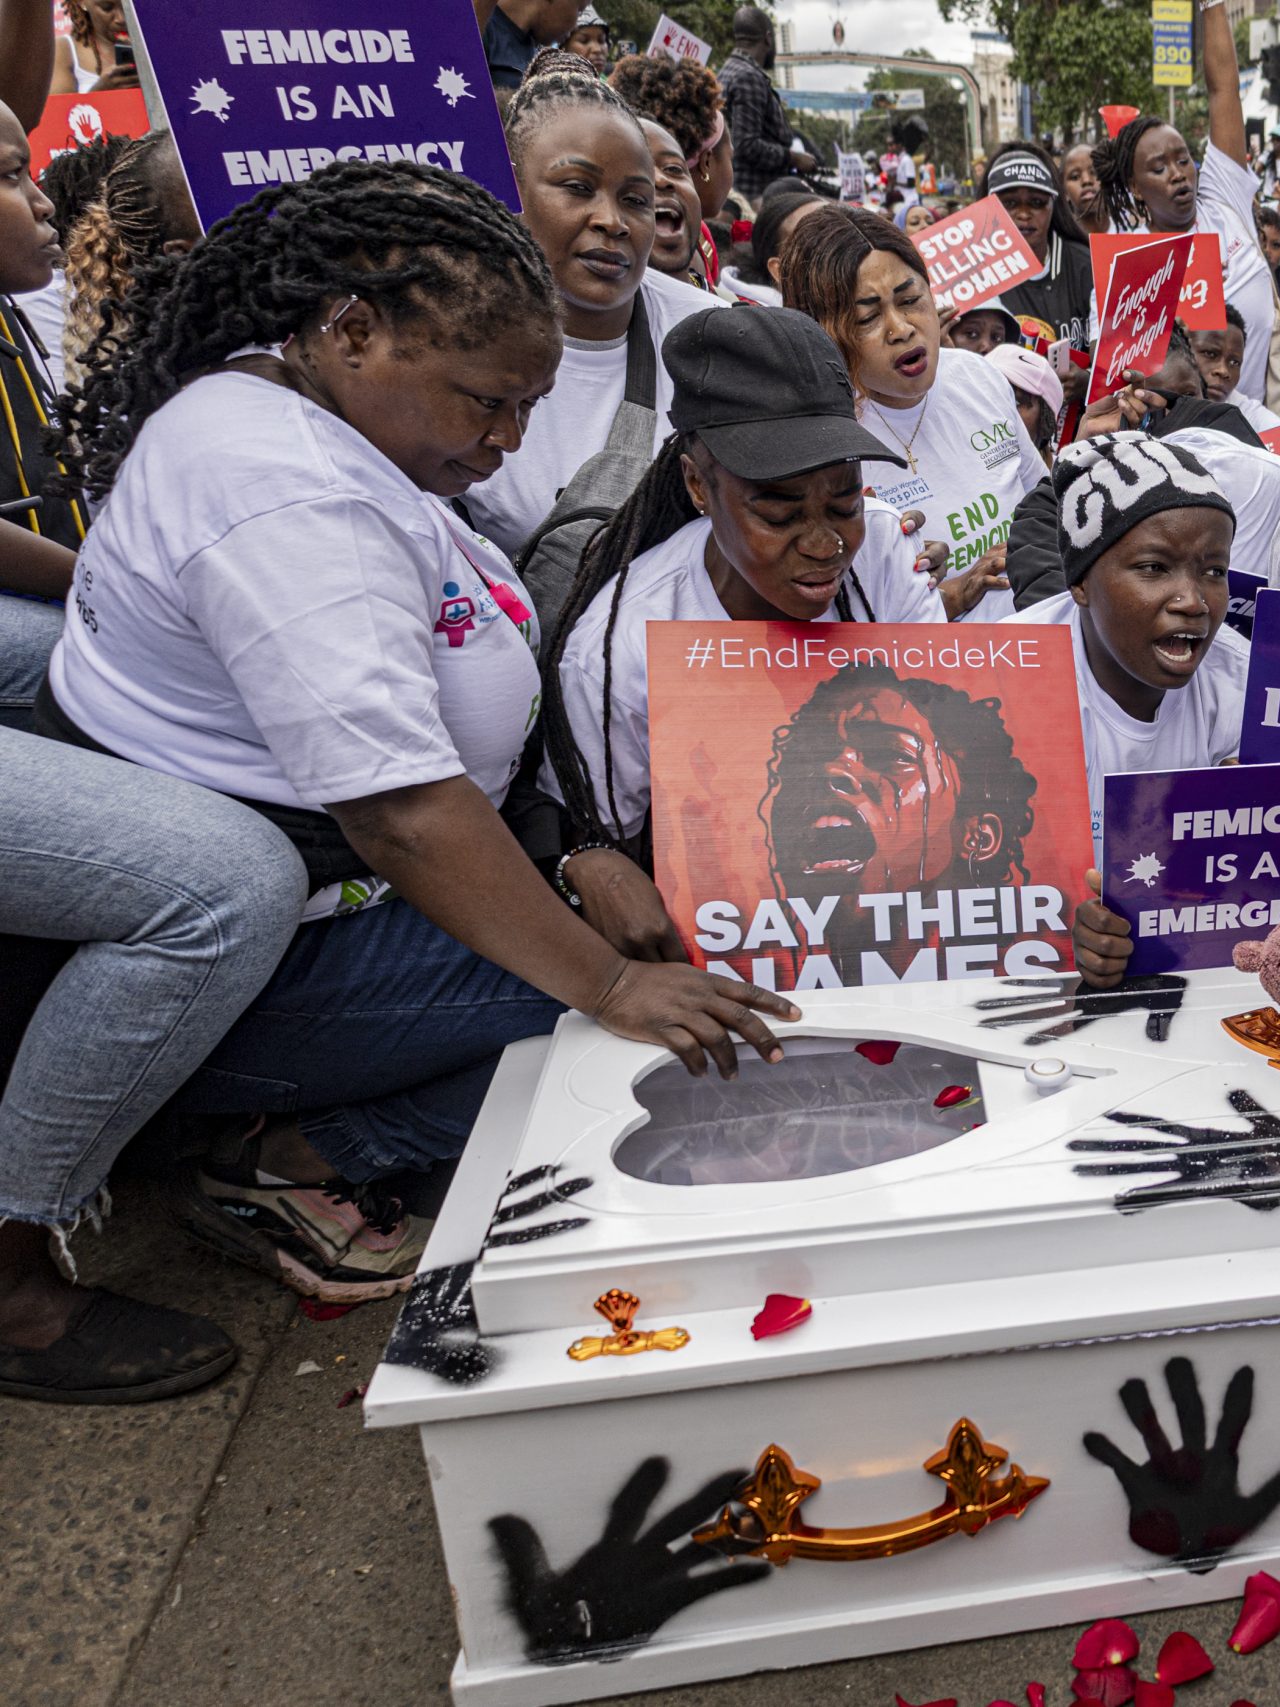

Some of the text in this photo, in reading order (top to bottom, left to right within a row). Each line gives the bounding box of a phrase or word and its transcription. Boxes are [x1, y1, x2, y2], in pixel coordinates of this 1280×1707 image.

[220, 29, 415, 64] FEMICIDE
[1154, 45, 1192, 63] 890
[276, 84, 396, 121] IS AN
[1004, 165, 1046, 180] CHANEL
[918, 219, 975, 260] STOP
[927, 229, 1013, 288] ILLING
[1112, 249, 1175, 330] Enough
[1132, 304, 1148, 336] is
[1105, 305, 1168, 387] Enough
[946, 492, 999, 541] END
[945, 512, 1016, 571] FEMICID
[684, 638, 1042, 668] #EndFemicideKE
[1204, 854, 1238, 884] IS
[694, 884, 1068, 952] SAY THEIR
